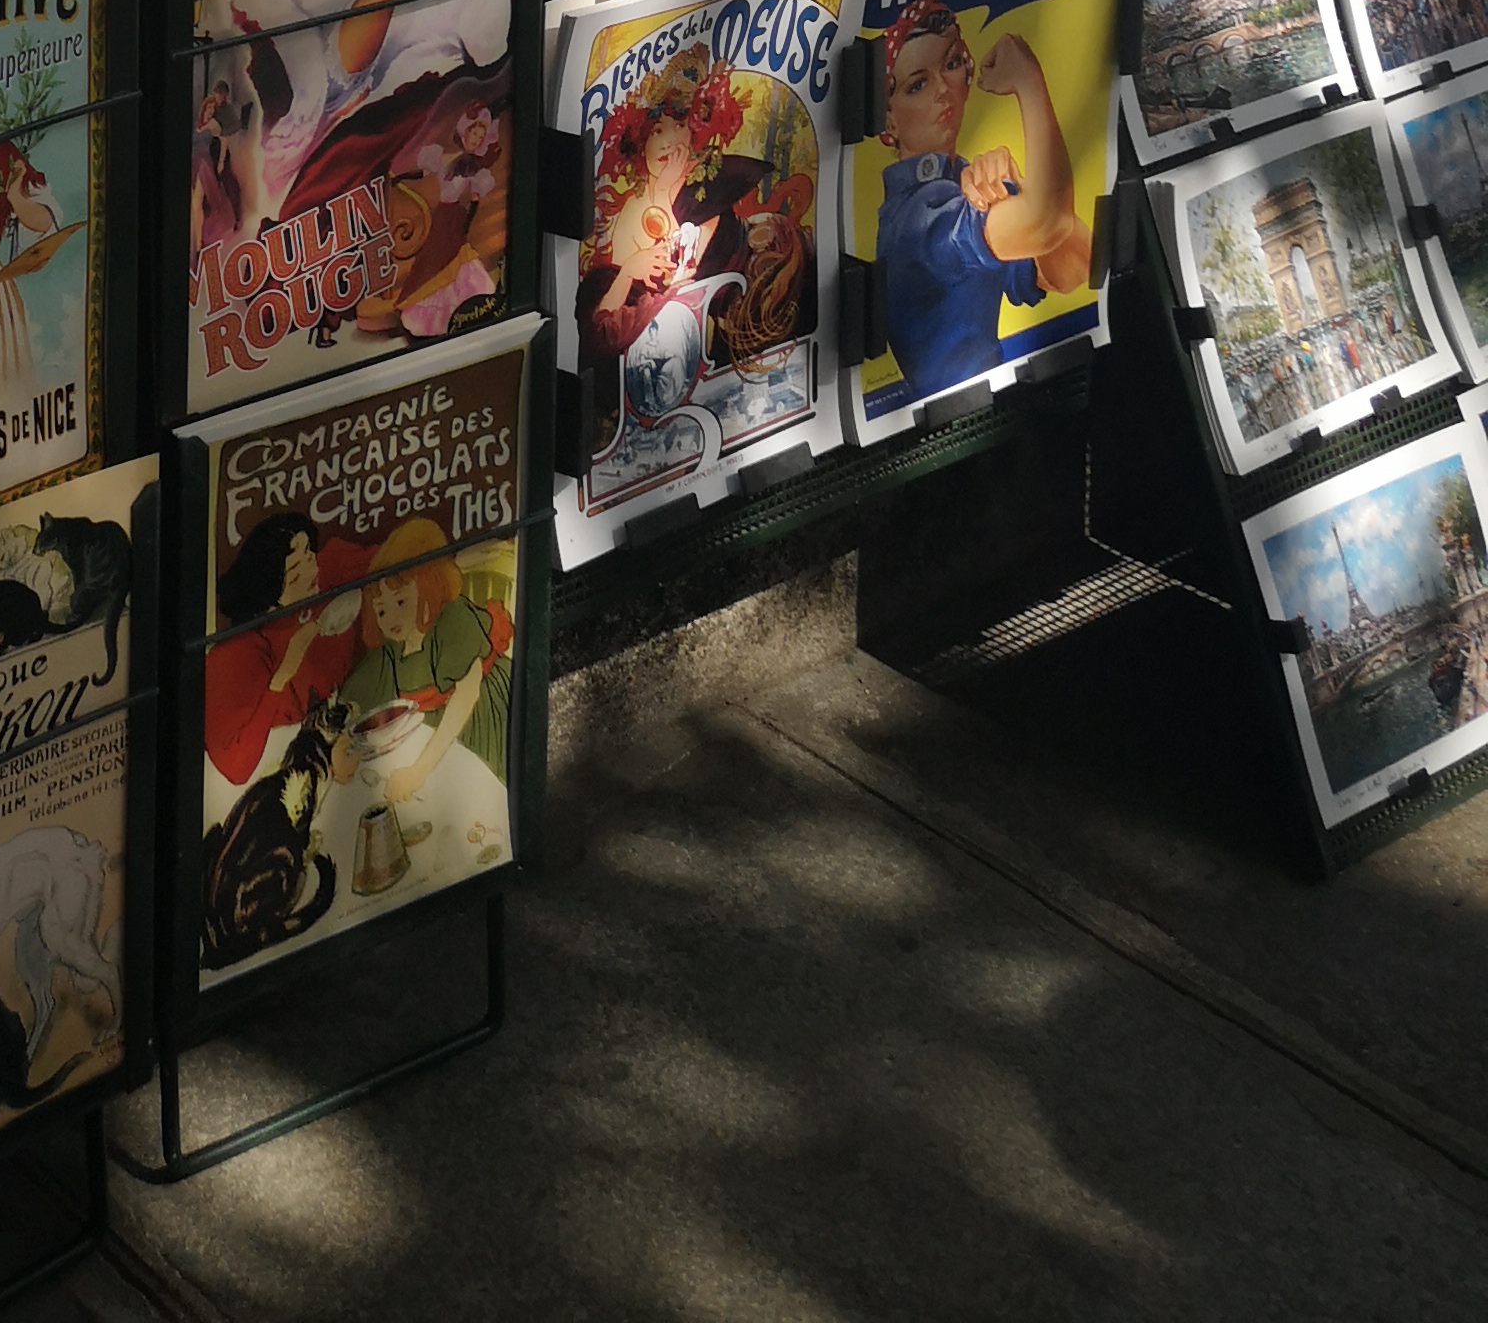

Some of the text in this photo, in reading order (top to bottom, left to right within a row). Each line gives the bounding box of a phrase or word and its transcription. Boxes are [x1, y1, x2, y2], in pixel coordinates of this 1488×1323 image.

[189, 176, 398, 379] MOULIN ROUGE
[12, 410, 30, 443] DE
[32, 382, 77, 445] NICE
[226, 384, 454, 482] COMPAGNIE
[451, 406, 494, 439] DES
[309, 427, 511, 526] CHOCOLATS
[355, 489, 442, 534] ET DES
[46, 755, 126, 797] PENSION
